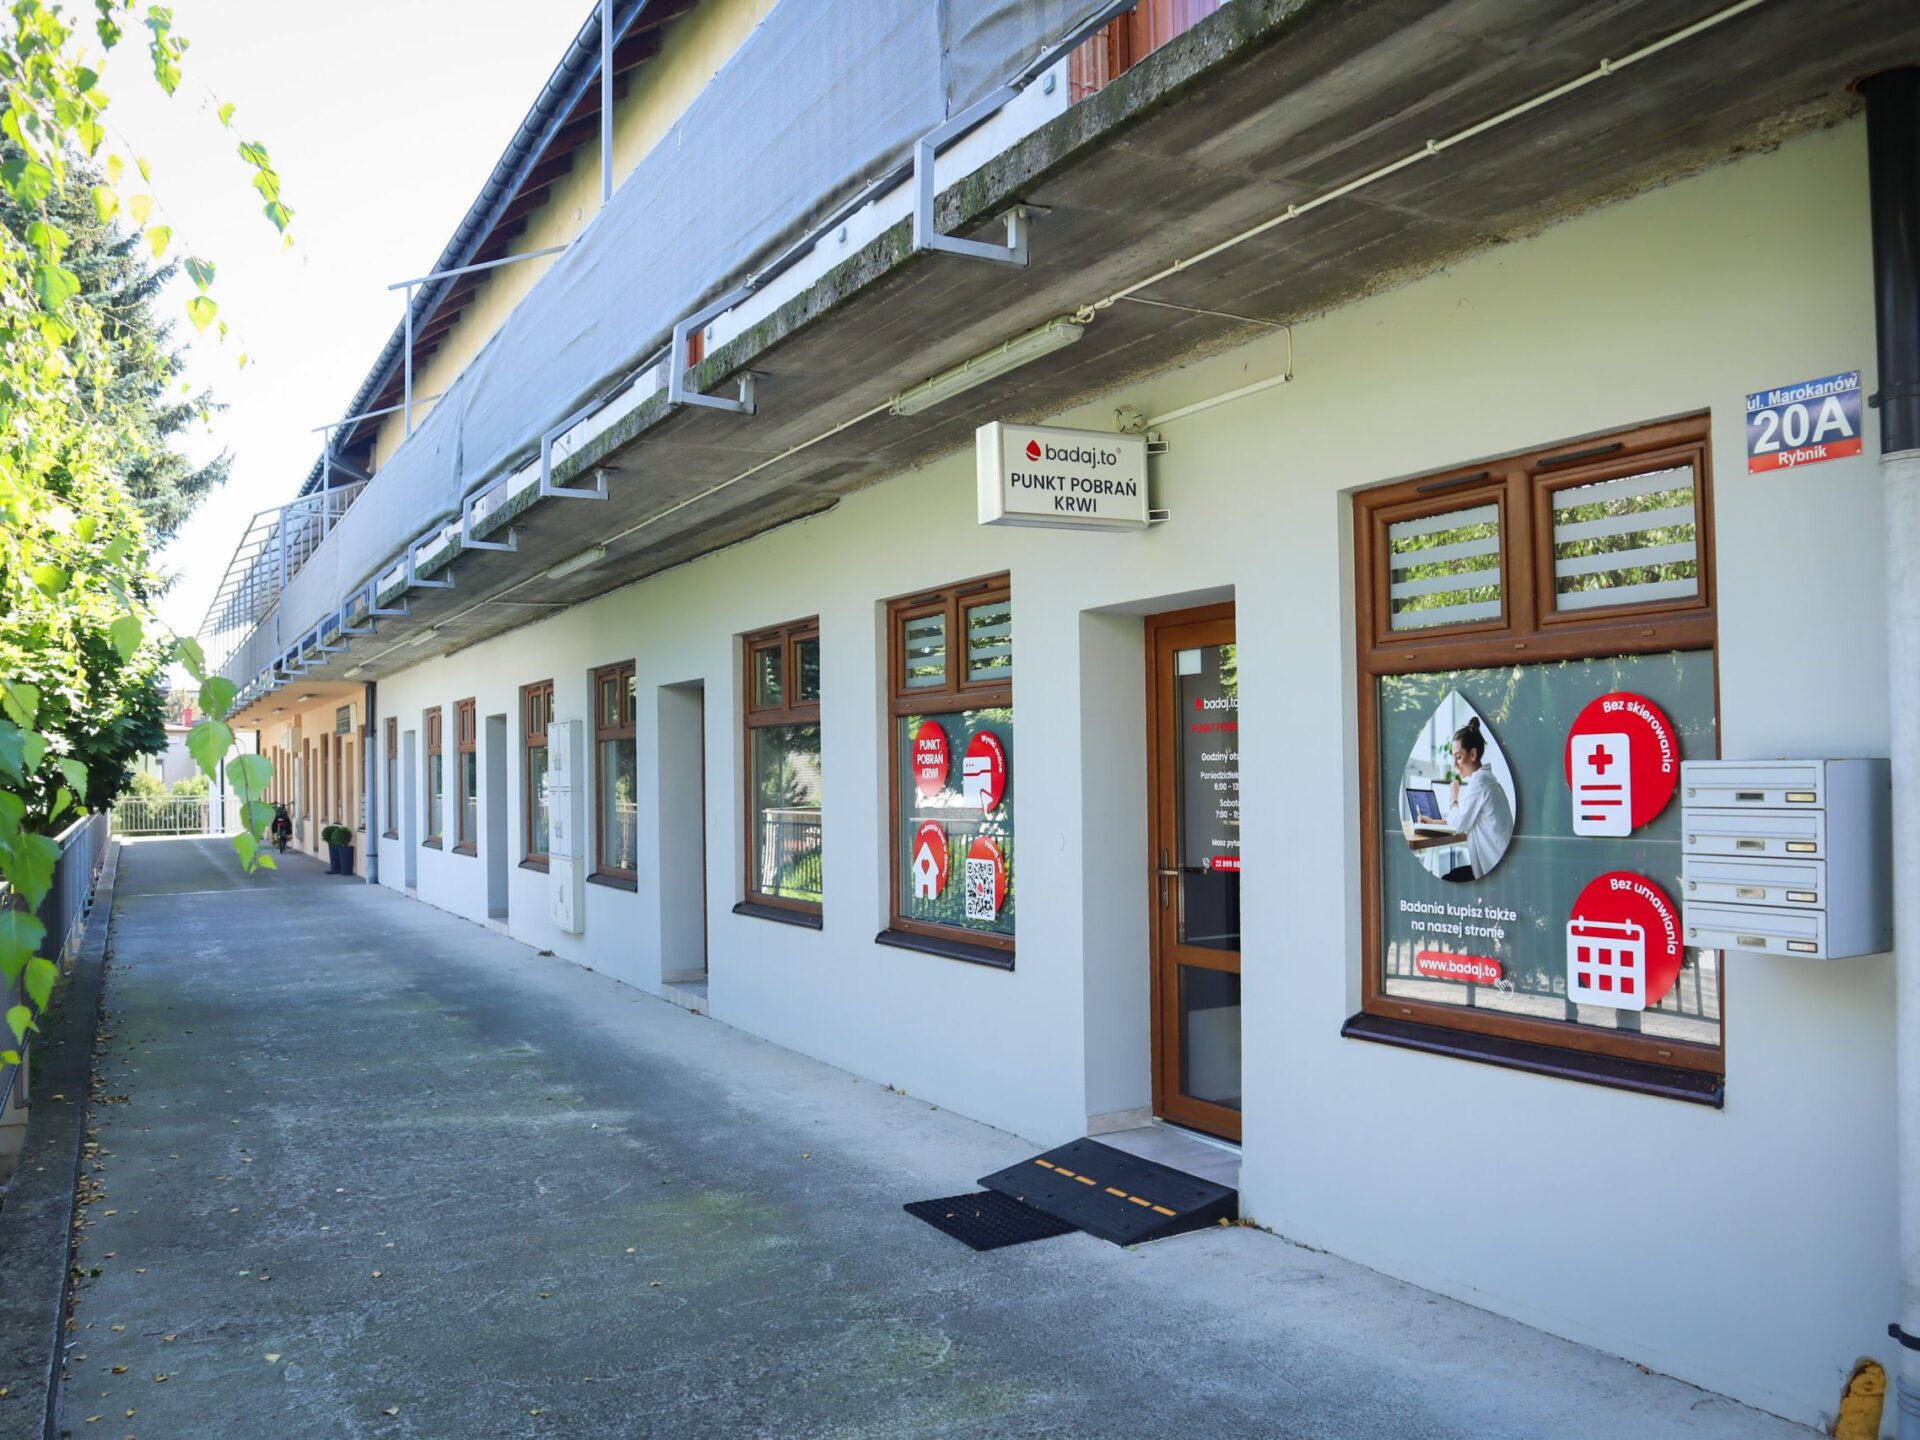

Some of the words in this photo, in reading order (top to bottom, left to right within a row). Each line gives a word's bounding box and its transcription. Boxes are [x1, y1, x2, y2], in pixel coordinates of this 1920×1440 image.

[1747, 396, 1764, 410] ul.
[1768, 375, 1858, 406] Marokanów
[1753, 395, 1854, 454] 20A
[1778, 445, 1827, 467] Rybnik
[1011, 472, 1066, 491] PUNKT
[1071, 477, 1137, 496] POBRAŃ
[1054, 495, 1097, 513] KRWI
[919, 739, 941, 750] PUNKT
[1602, 700, 1624, 713] Bez
[1626, 701, 1673, 774] skierowania
[916, 750, 944, 765] POBRAŃ
[1201, 751, 1228, 763] Godziny
[921, 767, 939, 779] KRWI
[1211, 839, 1226, 847] Masz
[1400, 899, 1445, 914] Badania
[1446, 901, 1483, 920] kupisz
[1484, 904, 1517, 921] także
[1609, 878, 1631, 892] Bez
[1633, 882, 1678, 955] umawiania
[1411, 921, 1425, 931] na
[1426, 921, 1463, 938] naszej
[1464, 924, 1505, 940] stronie
[1418, 957, 1498, 980] www.badaj.to
